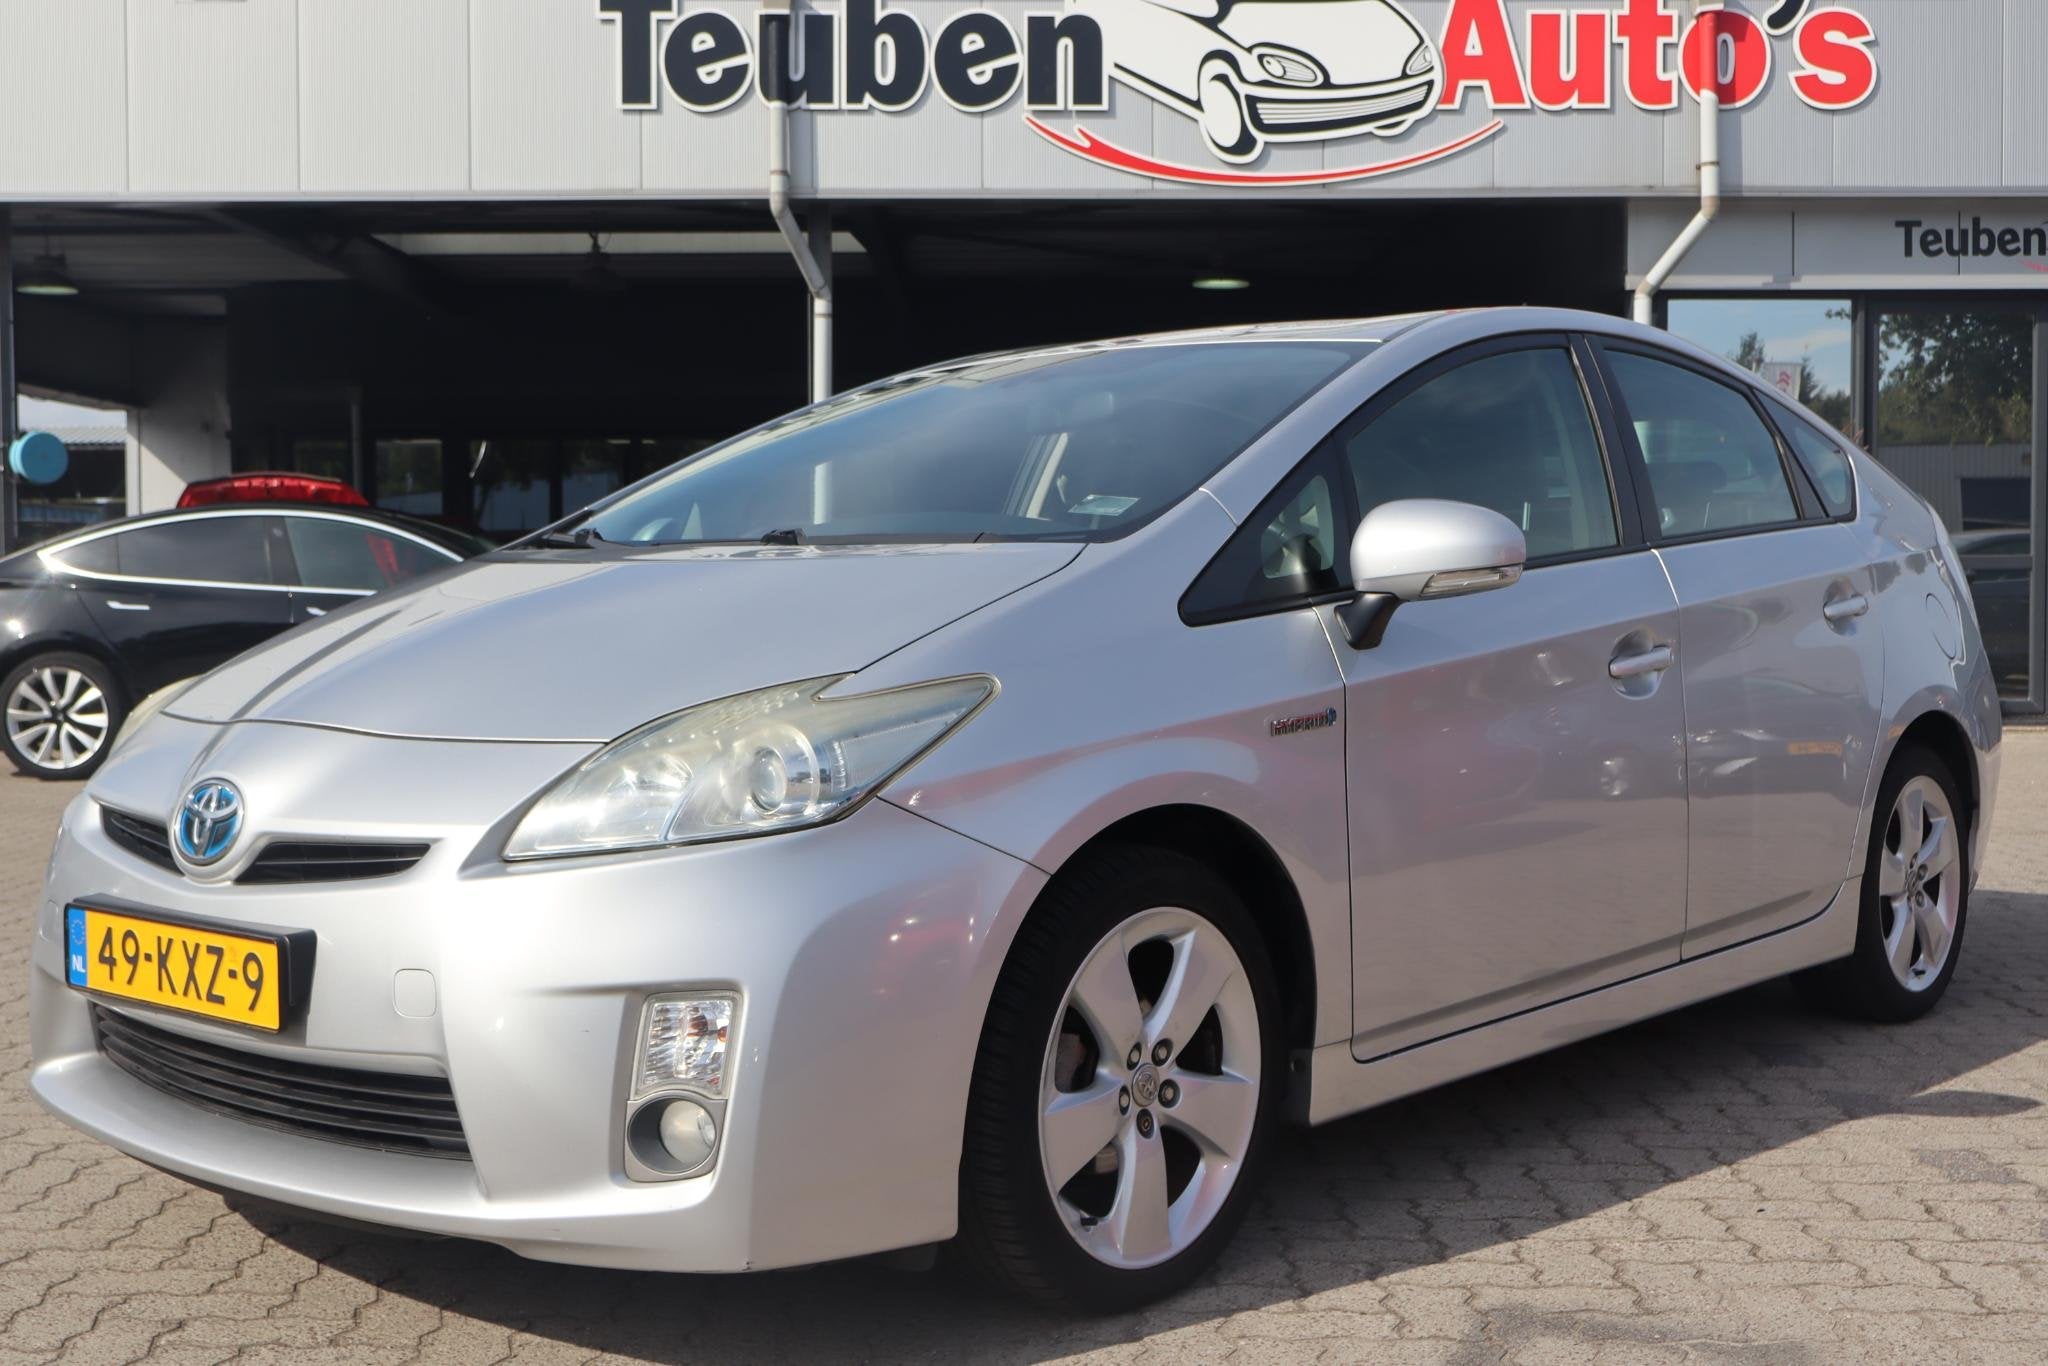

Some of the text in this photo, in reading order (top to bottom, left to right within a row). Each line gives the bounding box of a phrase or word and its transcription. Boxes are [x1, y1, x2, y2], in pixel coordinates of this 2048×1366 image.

[599, 0, 1872, 106] Teuben Auto's
[1894, 216, 2047, 258] Teuben
[72, 954, 86, 973] NL
[98, 926, 264, 1012] 49-KXZ-9
